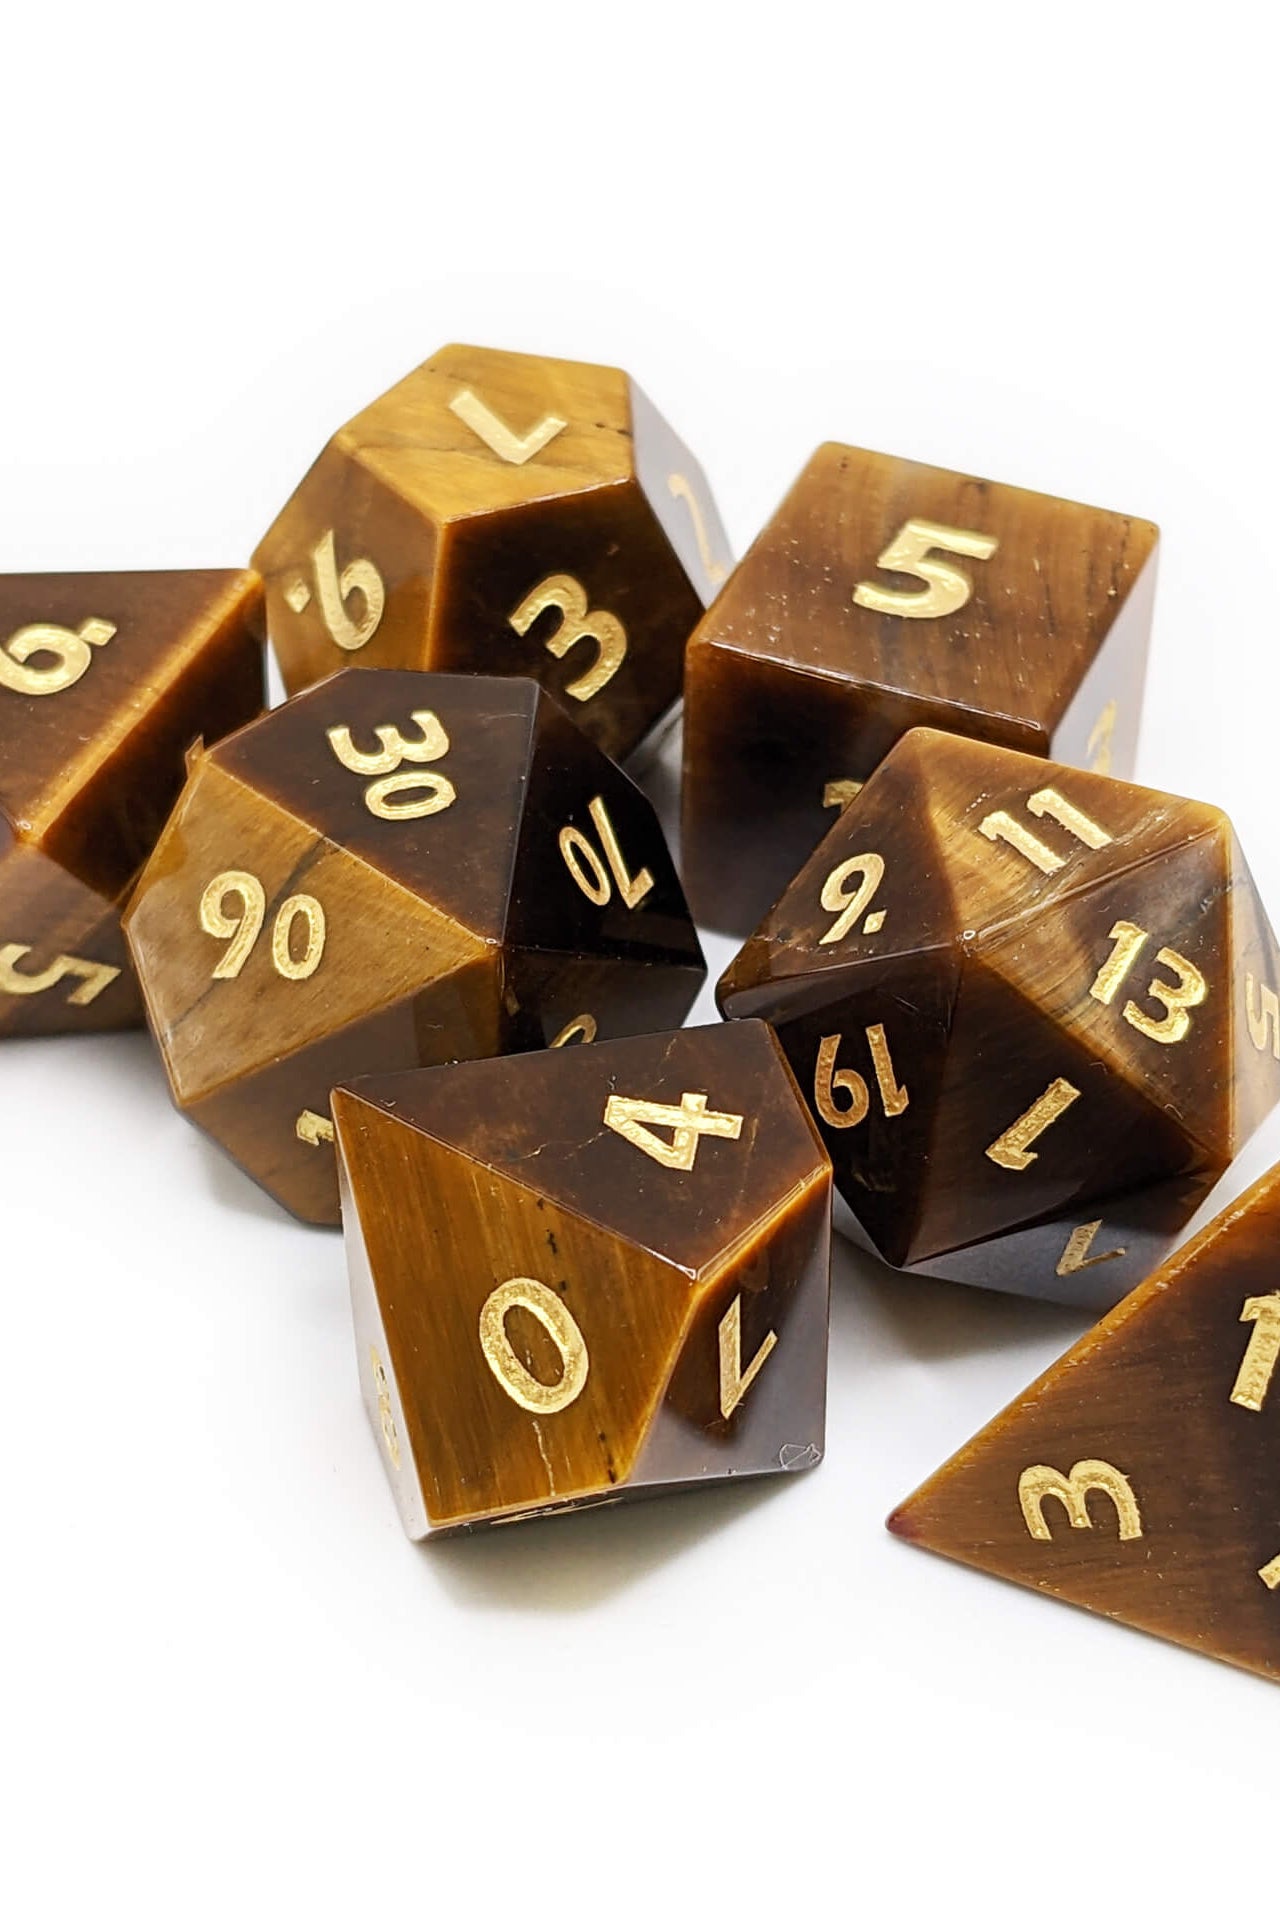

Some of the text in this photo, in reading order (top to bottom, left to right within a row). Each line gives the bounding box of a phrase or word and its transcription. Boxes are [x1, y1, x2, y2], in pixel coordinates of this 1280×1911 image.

[853, 518, 998, 619] 5
[508, 574, 628, 701] 3
[327, 710, 457, 821] 30
[559, 796, 654, 909] 70
[978, 787, 1114, 875] 11
[0, 943, 122, 1006] 5
[199, 870, 326, 980] 90
[1088, 919, 1207, 1044] 13
[1245, 971, 1280, 1060] 5
[814, 1022, 909, 1128] 19
[984, 1077, 1081, 1170] 1
[603, 1092, 744, 1171] 4
[479, 1276, 589, 1414] 0
[1229, 1290, 1280, 1411] 1
[1018, 1459, 1143, 1541] 3
